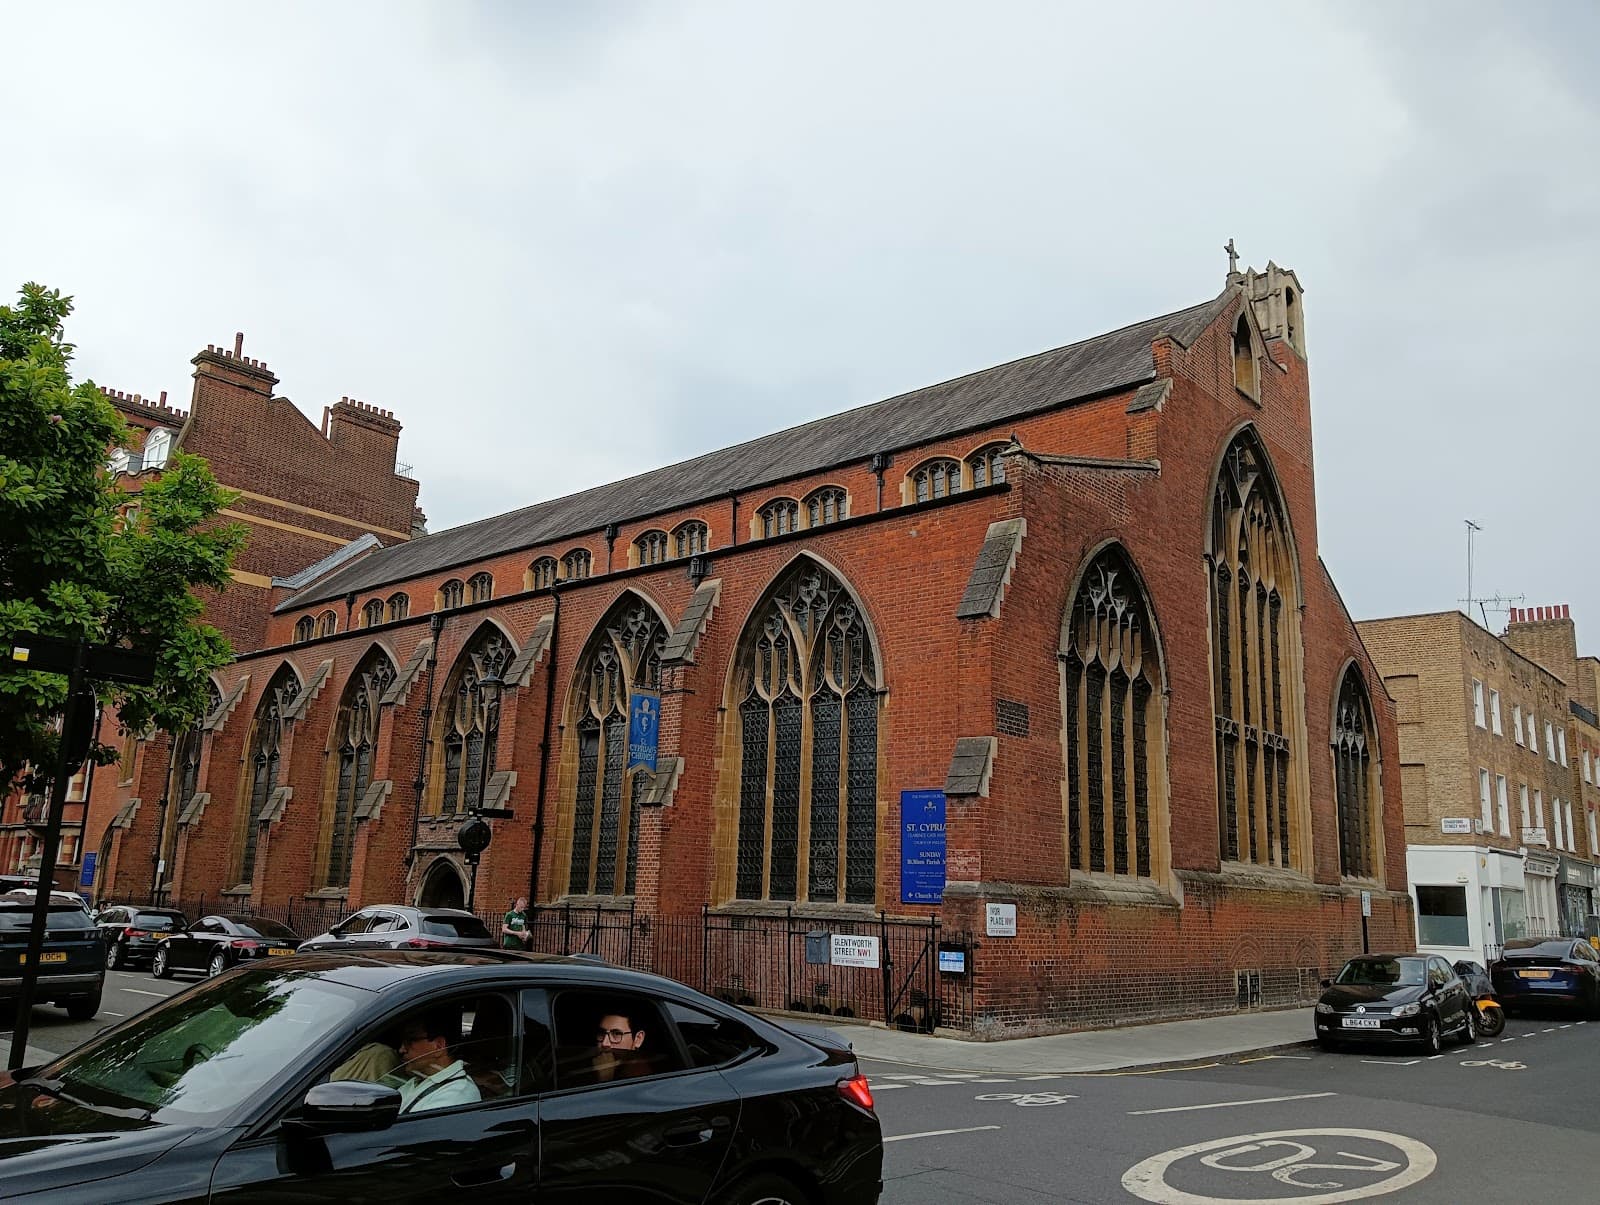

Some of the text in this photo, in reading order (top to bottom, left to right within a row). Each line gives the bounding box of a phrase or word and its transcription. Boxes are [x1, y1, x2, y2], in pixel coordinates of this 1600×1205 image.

[906, 823, 946, 832] ST. CYPRIA
[834, 938, 872, 948] GLENTWORTH
[834, 947, 871, 957] STREET NW1
[1200, 1140, 1402, 1189] 20
